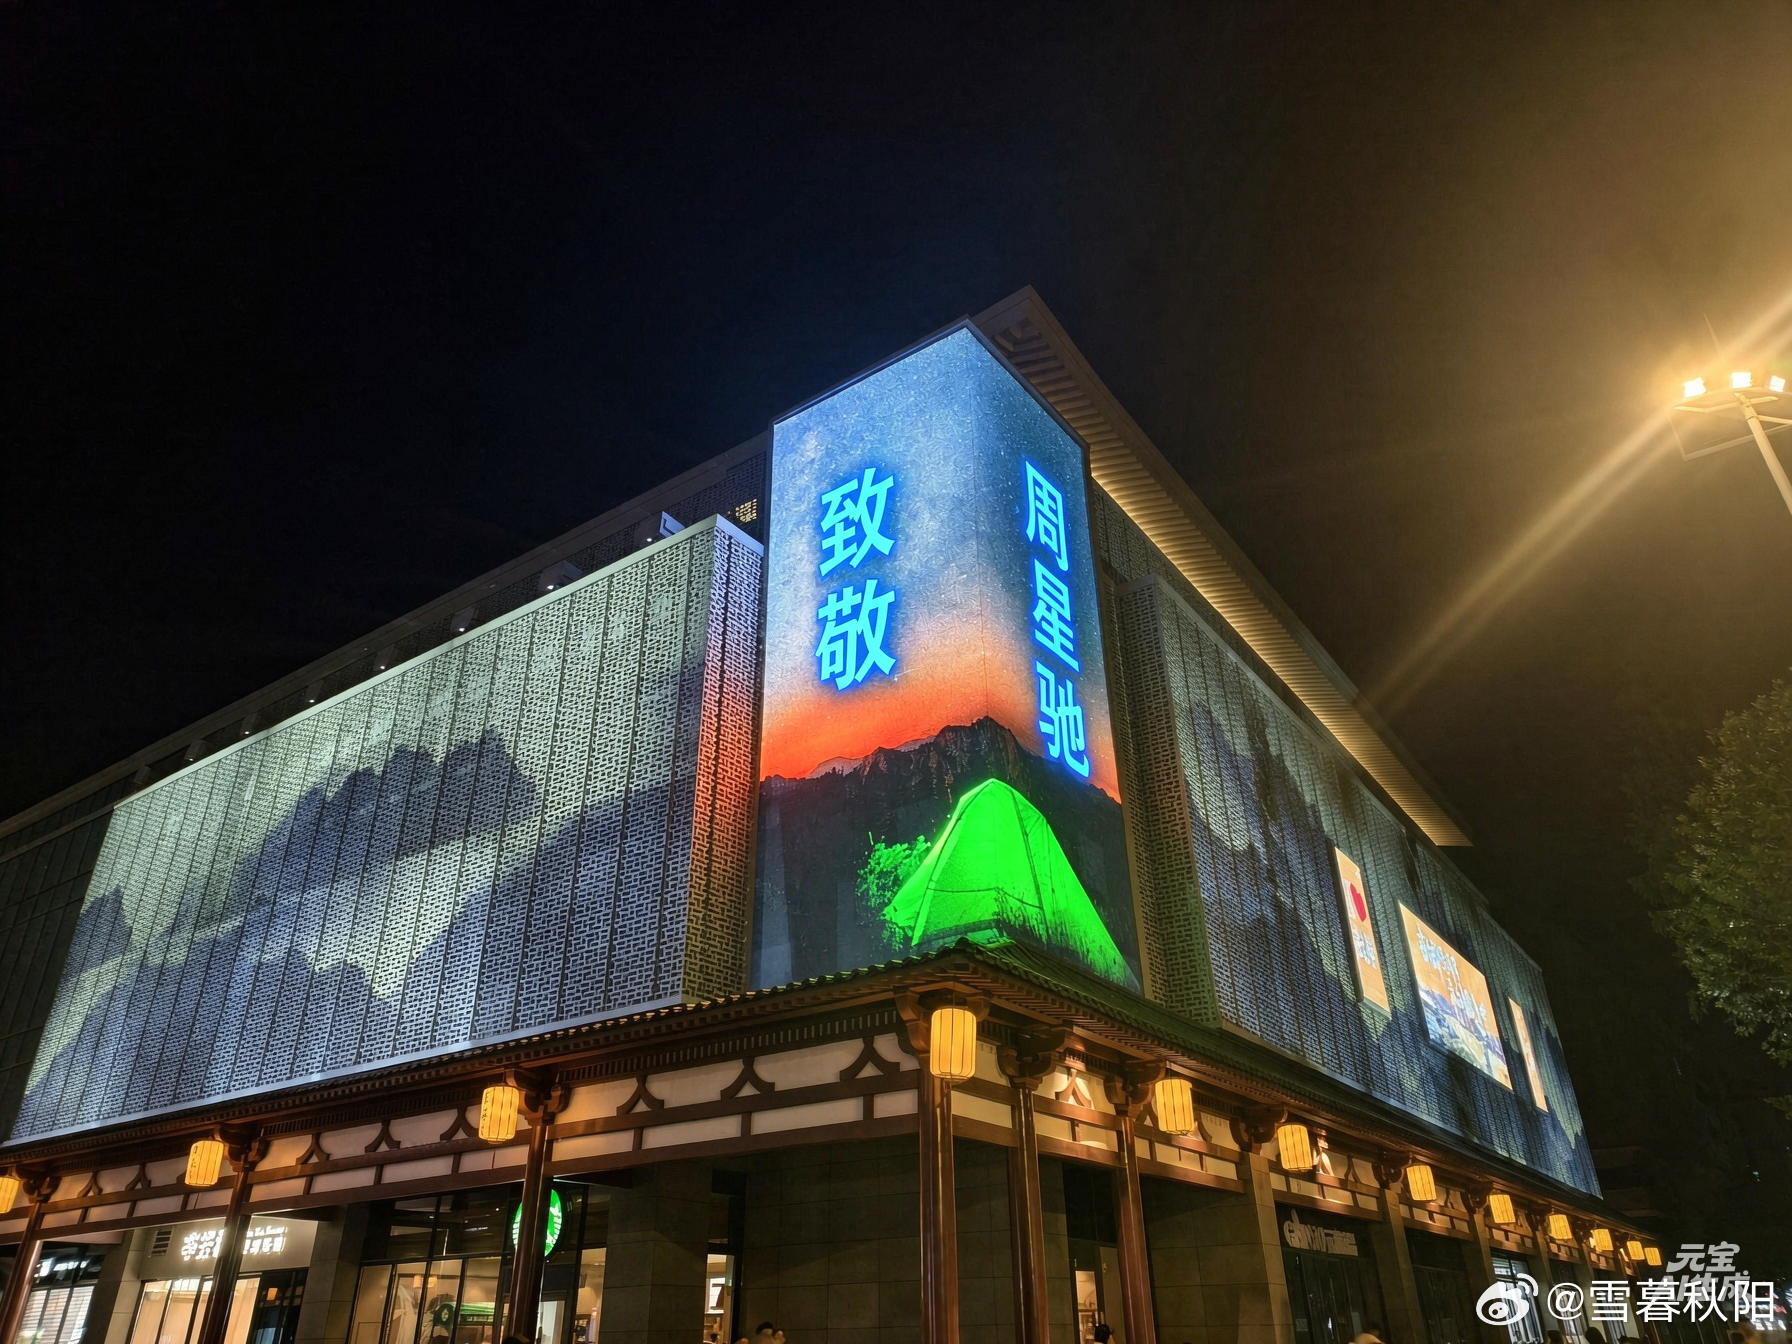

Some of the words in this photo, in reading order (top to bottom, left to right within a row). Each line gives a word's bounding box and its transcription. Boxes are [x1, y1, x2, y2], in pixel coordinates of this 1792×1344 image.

[815, 466, 897, 691] 致敬
[1024, 460, 1090, 778] 周星驰
